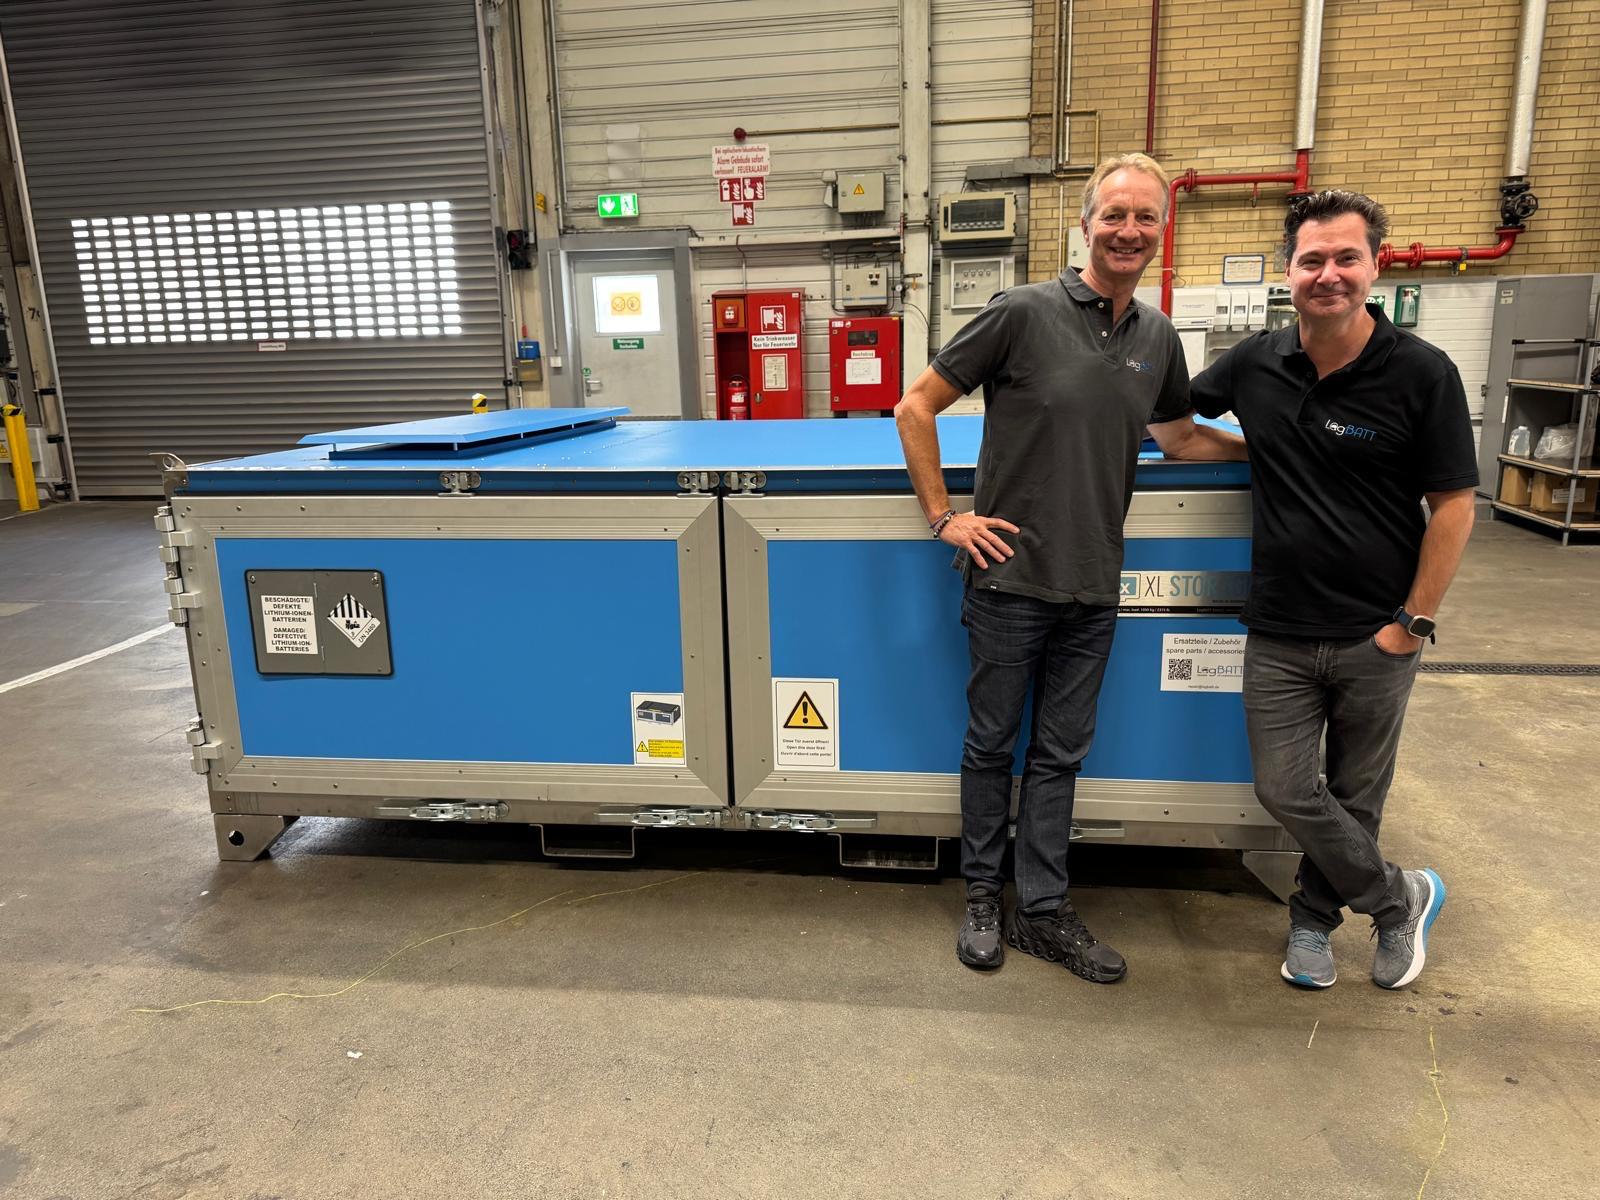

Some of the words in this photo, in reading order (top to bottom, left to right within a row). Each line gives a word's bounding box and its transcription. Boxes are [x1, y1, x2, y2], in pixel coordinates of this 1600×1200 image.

[717, 156, 730, 165] Alarm
[731, 155, 750, 164] Gebäude
[751, 154, 764, 163] sofort
[1325, 419, 1377, 441] LogBATT
[1145, 576, 1164, 597] XL
[358, 633, 367, 643] UN
[1174, 637, 1208, 645] Ersatzteile
